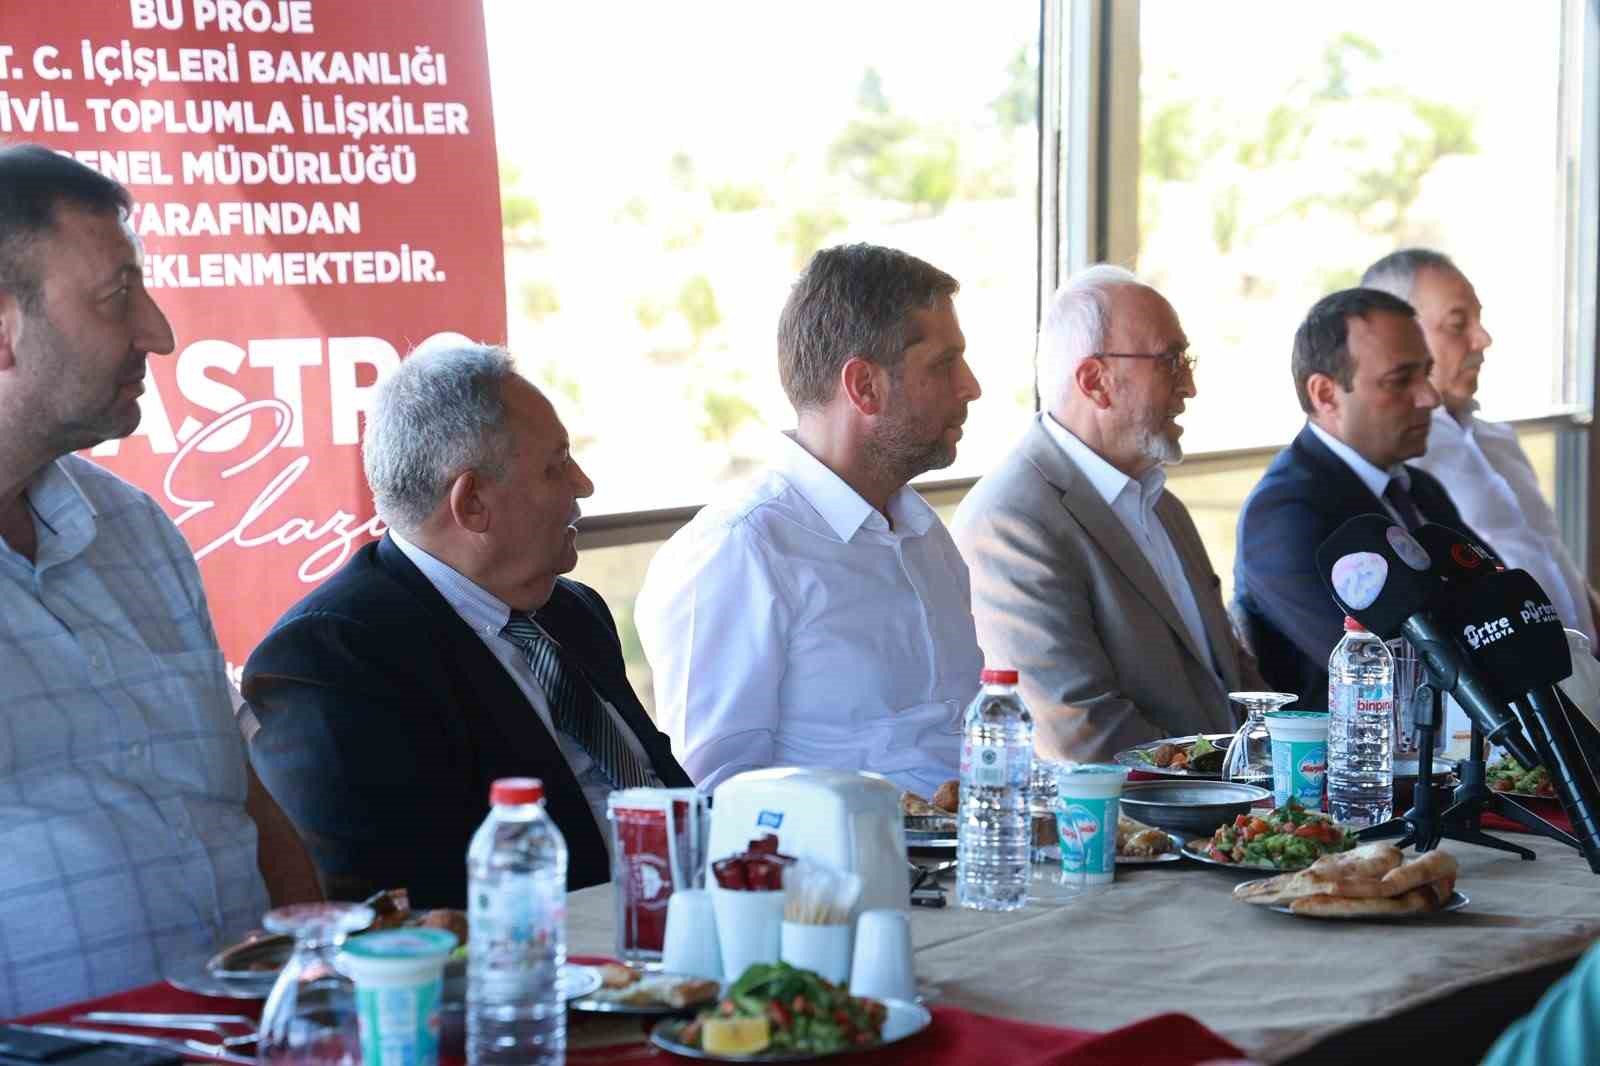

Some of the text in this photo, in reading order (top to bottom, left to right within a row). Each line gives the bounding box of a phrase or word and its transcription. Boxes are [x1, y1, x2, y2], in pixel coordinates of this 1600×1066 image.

[131, 0, 314, 33] BU PROJE
[33, 46, 72, 80] C.
[82, 39, 239, 87] İÇİŞLERİ
[249, 46, 448, 86] BAKANLIĞI
[0, 91, 469, 139] İVİL TOPLUMLA İLİŞKİLER
[56, 145, 418, 187] ENEL MÜDÜRLÜĞÜ
[144, 244, 447, 288] EKLENMEKTEDİR.
[1481, 627, 1515, 646] MEDYA
